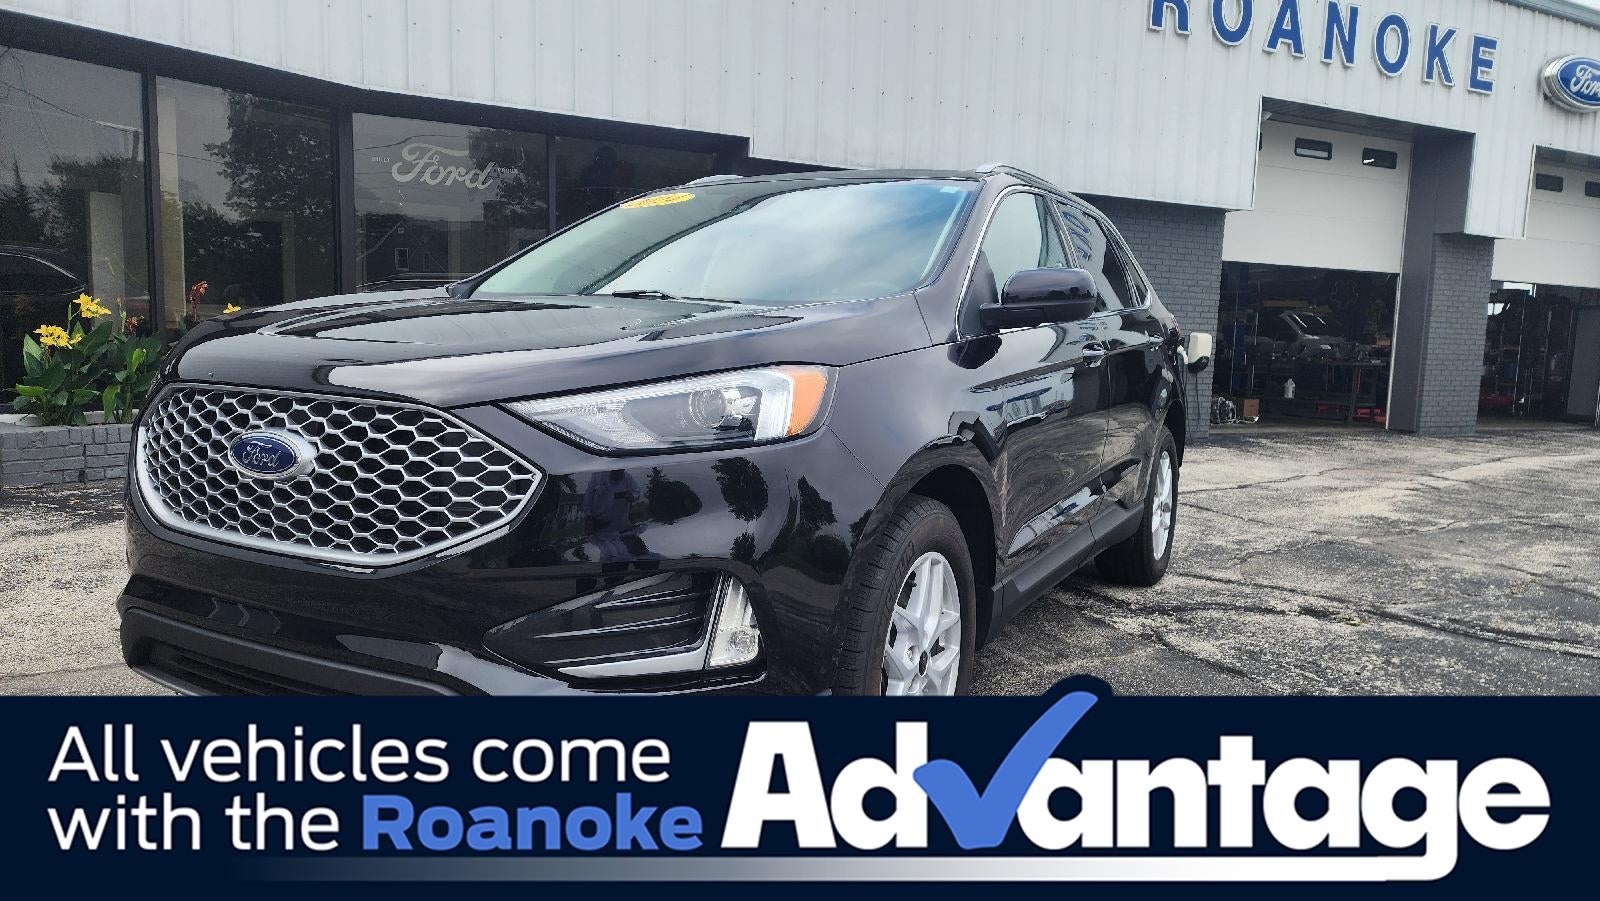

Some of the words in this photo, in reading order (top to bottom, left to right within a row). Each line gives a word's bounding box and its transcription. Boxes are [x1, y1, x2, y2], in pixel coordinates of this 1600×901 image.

[1148, 0, 1499, 94] ROANOKE
[391, 142, 496, 190] Ford
[242, 440, 282, 467] Ford
